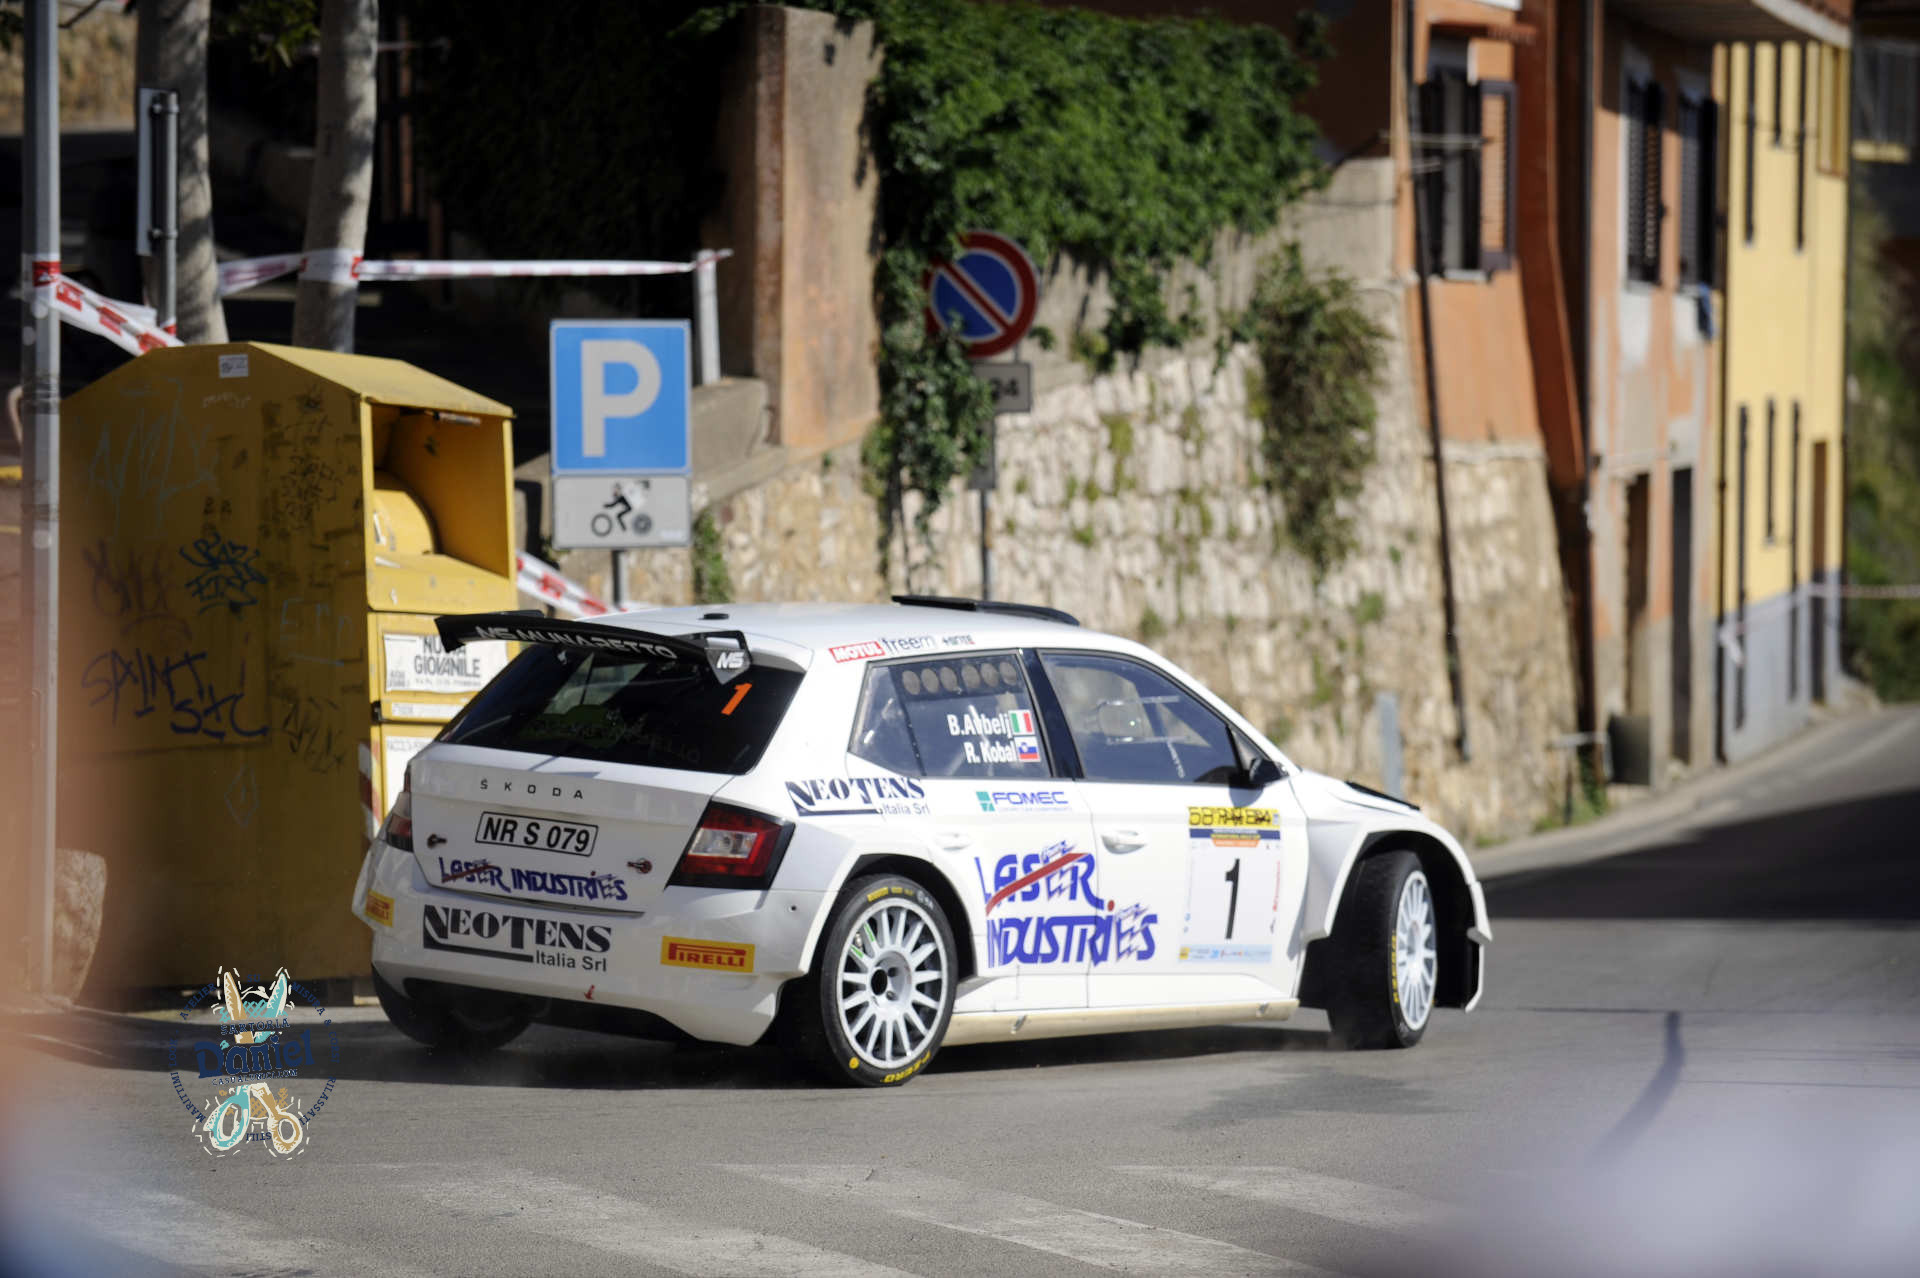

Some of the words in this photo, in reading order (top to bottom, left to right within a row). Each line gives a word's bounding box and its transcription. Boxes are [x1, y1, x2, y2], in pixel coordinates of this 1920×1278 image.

[581, 340, 661, 457] P
[832, 642, 883, 661] MOTUL
[414, 655, 481, 678] GIOVANILE
[720, 682, 752, 715] 1
[785, 777, 925, 808] NEOTENS
[992, 791, 1069, 805] FOMEC
[883, 803, 911, 815] Italia
[912, 803, 930, 815] Srl
[482, 817, 518, 843] NR
[523, 822, 541, 846] S
[546, 826, 590, 853] 079
[1225, 858, 1240, 939] 1
[423, 904, 612, 954] NEOTENS
[535, 950, 576, 968] Italia
[582, 953, 607, 972] Srl
[668, 942, 746, 967] PIRELLI
